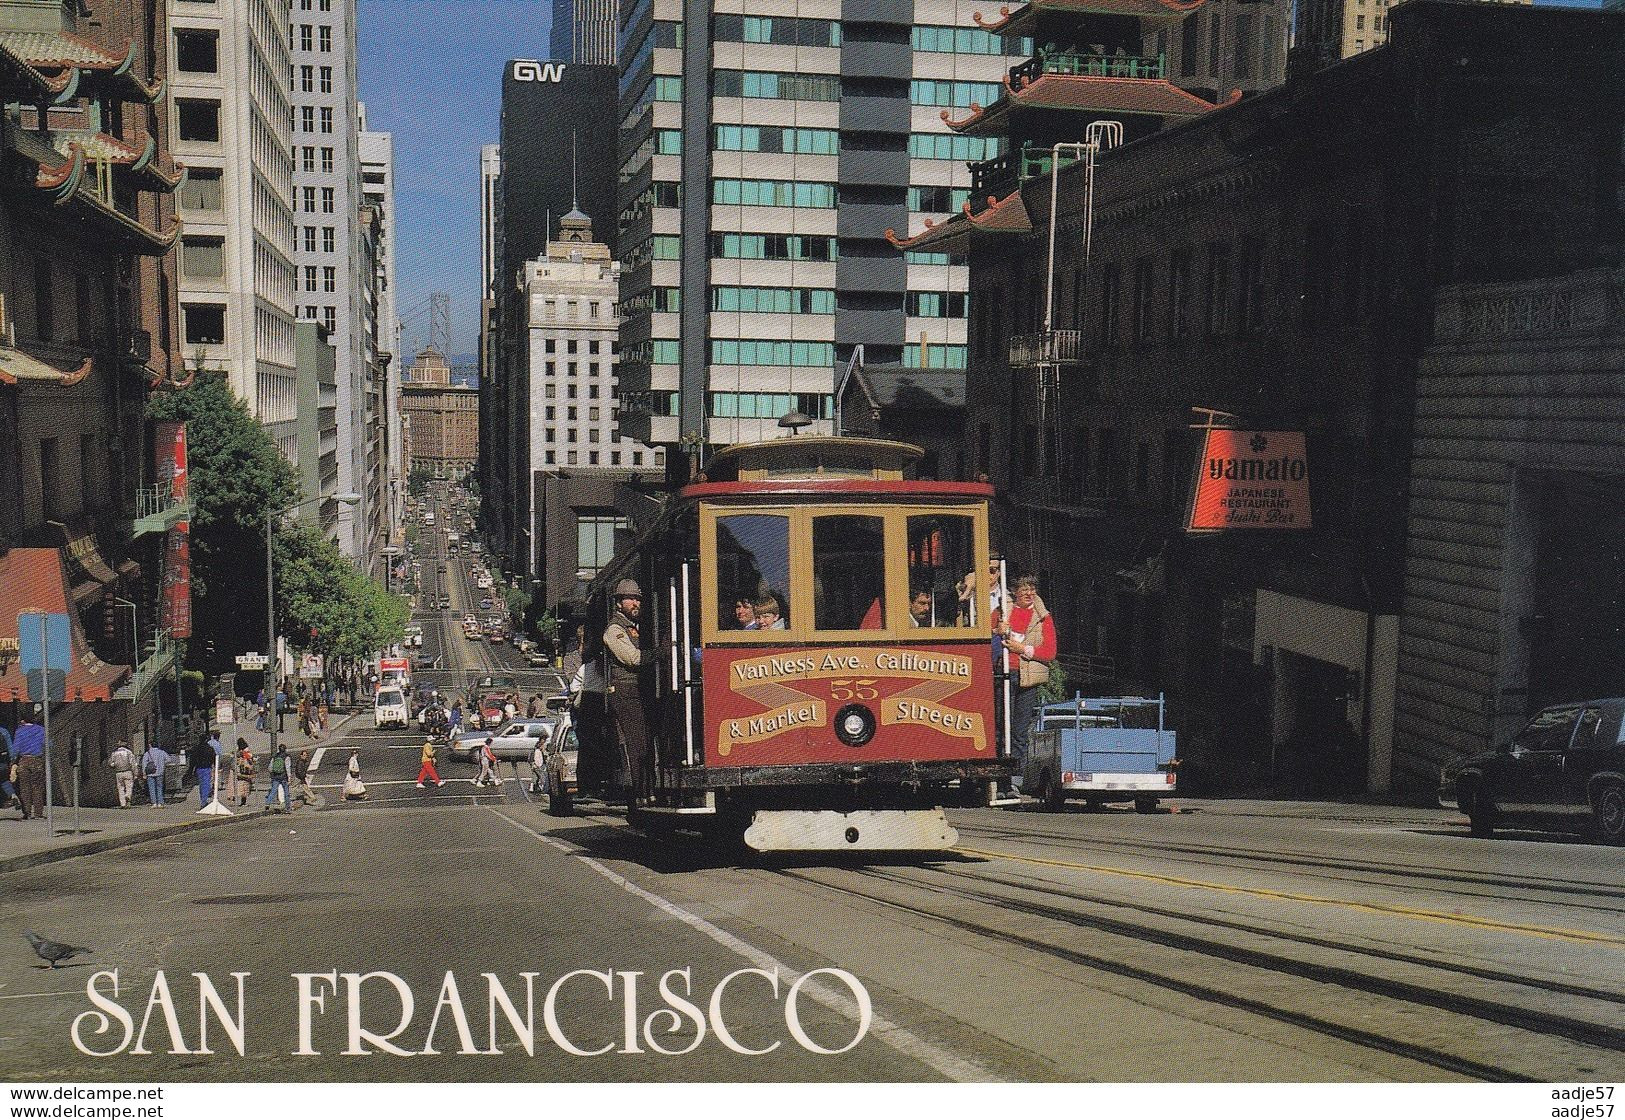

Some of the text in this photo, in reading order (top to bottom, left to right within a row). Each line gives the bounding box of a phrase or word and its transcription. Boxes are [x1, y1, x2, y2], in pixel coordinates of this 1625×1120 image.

[513, 61, 566, 83] GW
[1210, 456, 1306, 480] yamato
[1220, 499, 1291, 509] RESTAURANT
[1227, 488, 1286, 498] JAPANESE
[1225, 508, 1261, 523] Sushi
[1265, 508, 1296, 522] Bar
[734, 662, 769, 681] Van
[771, 657, 815, 676] Ness
[875, 652, 969, 676] California
[831, 679, 879, 700] 55
[730, 704, 817, 738] & Market
[896, 701, 973, 730] Streets
